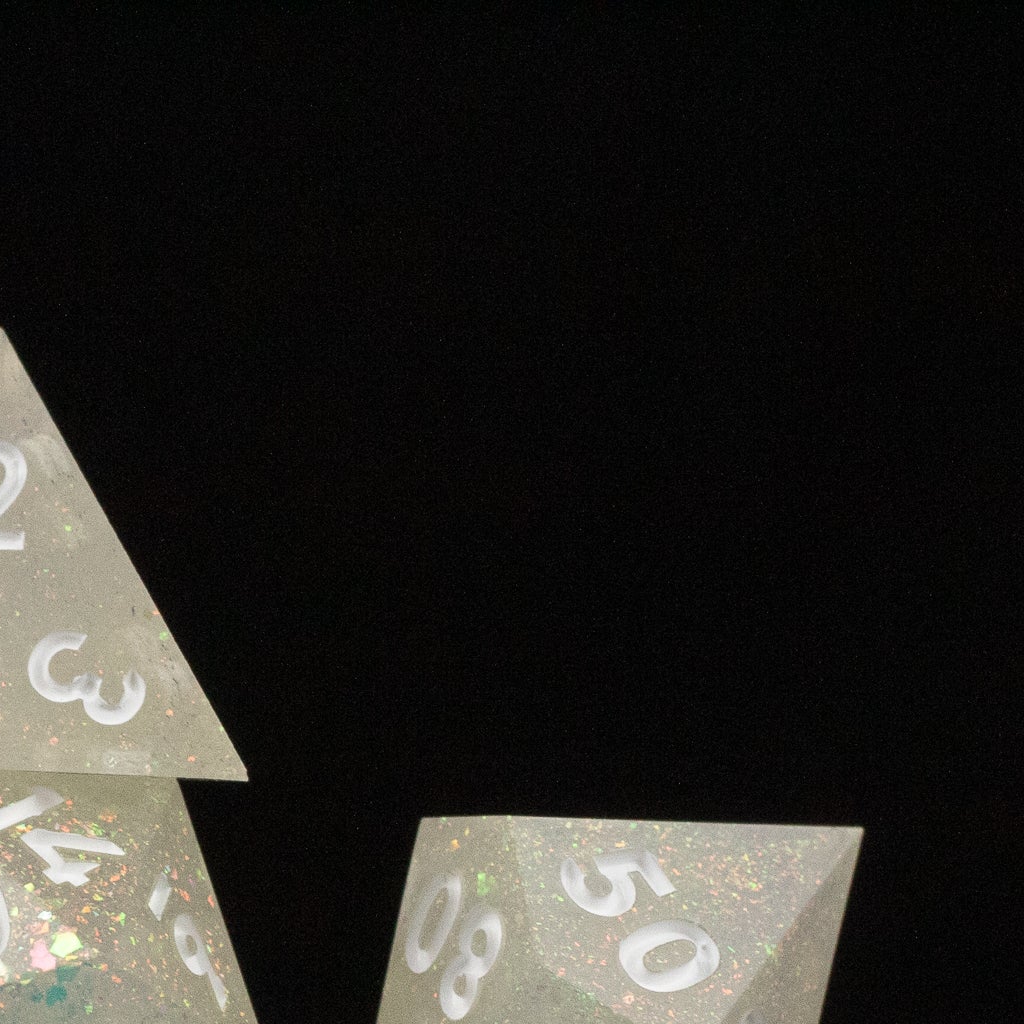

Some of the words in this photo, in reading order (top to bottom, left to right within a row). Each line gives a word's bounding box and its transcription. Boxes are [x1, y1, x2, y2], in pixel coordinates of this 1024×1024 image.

[27, 630, 146, 726] 3
[404, 873, 502, 1021] 80
[560, 848, 720, 992] 50
